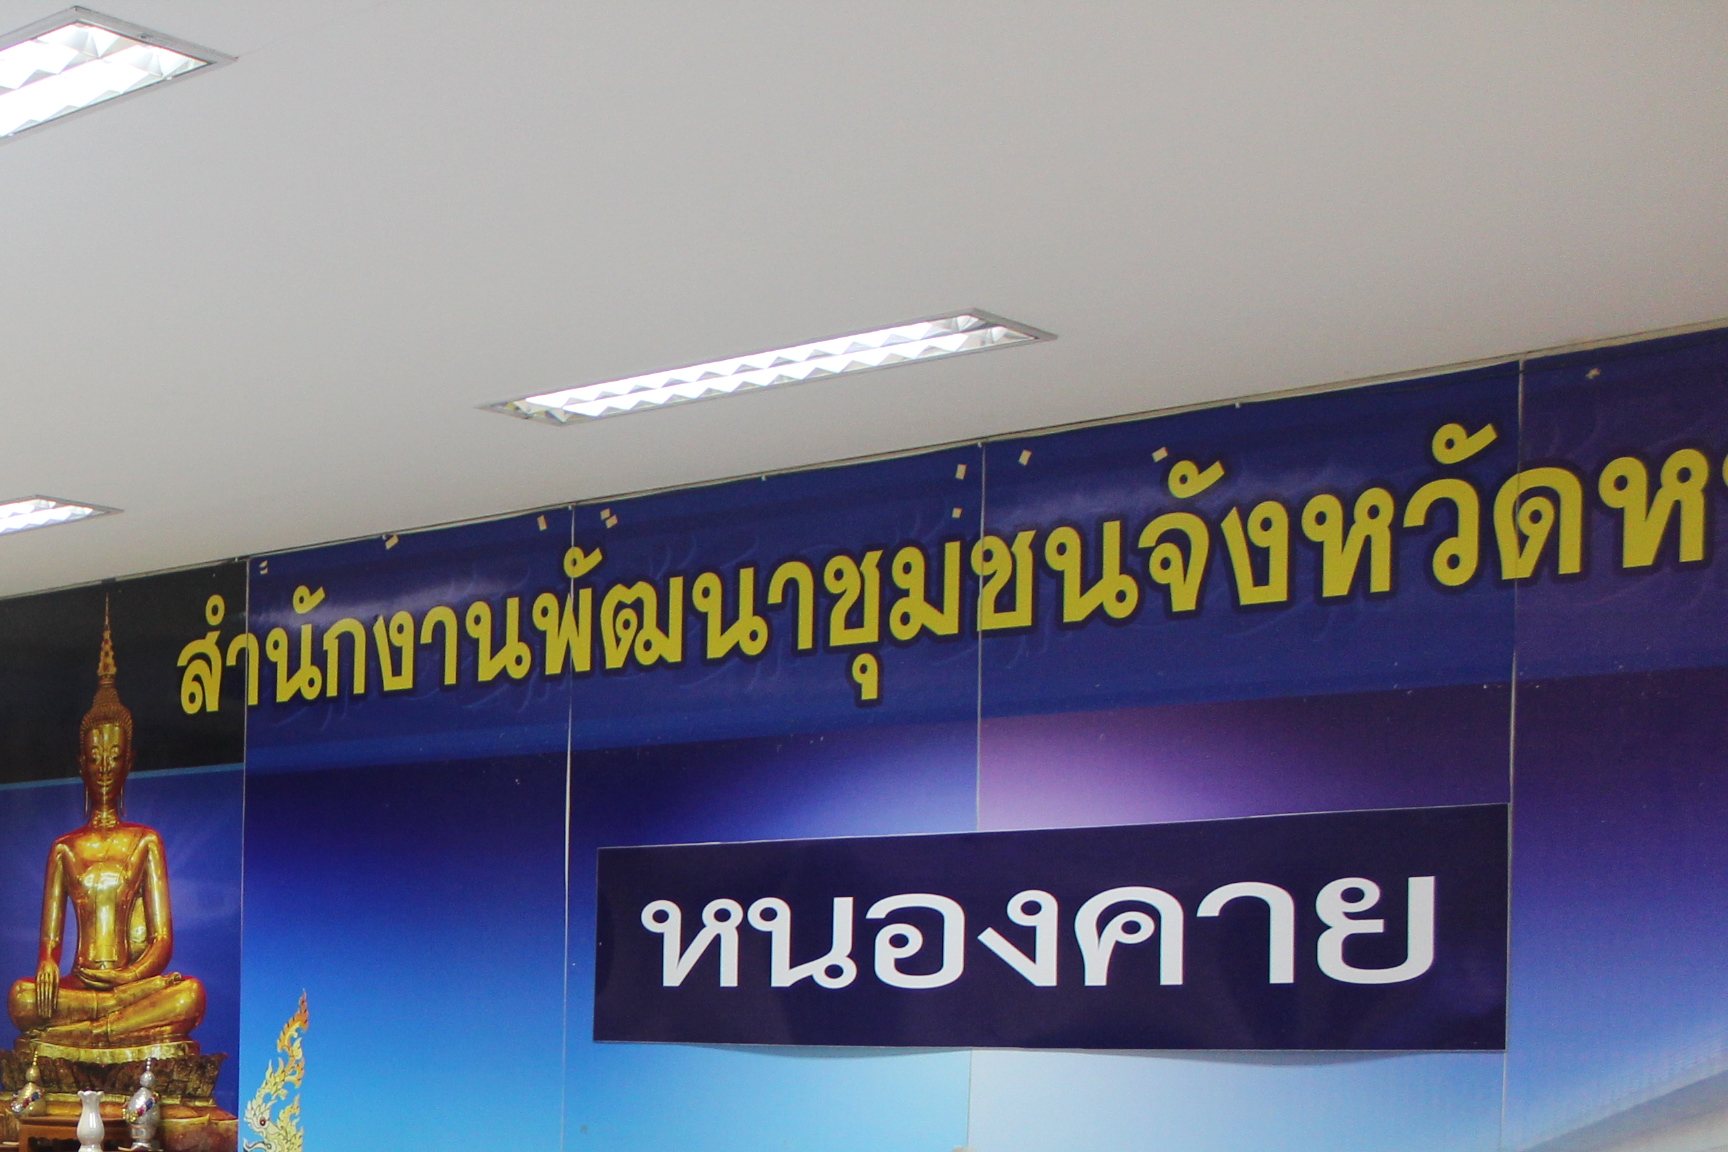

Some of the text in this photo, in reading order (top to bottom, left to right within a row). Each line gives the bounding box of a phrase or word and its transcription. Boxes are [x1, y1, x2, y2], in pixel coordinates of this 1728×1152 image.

[177, 423, 1728, 714] สำนักงานพัฒนาชุมชนจังหวัดห
[641, 875, 1436, 989] หนองคาย
